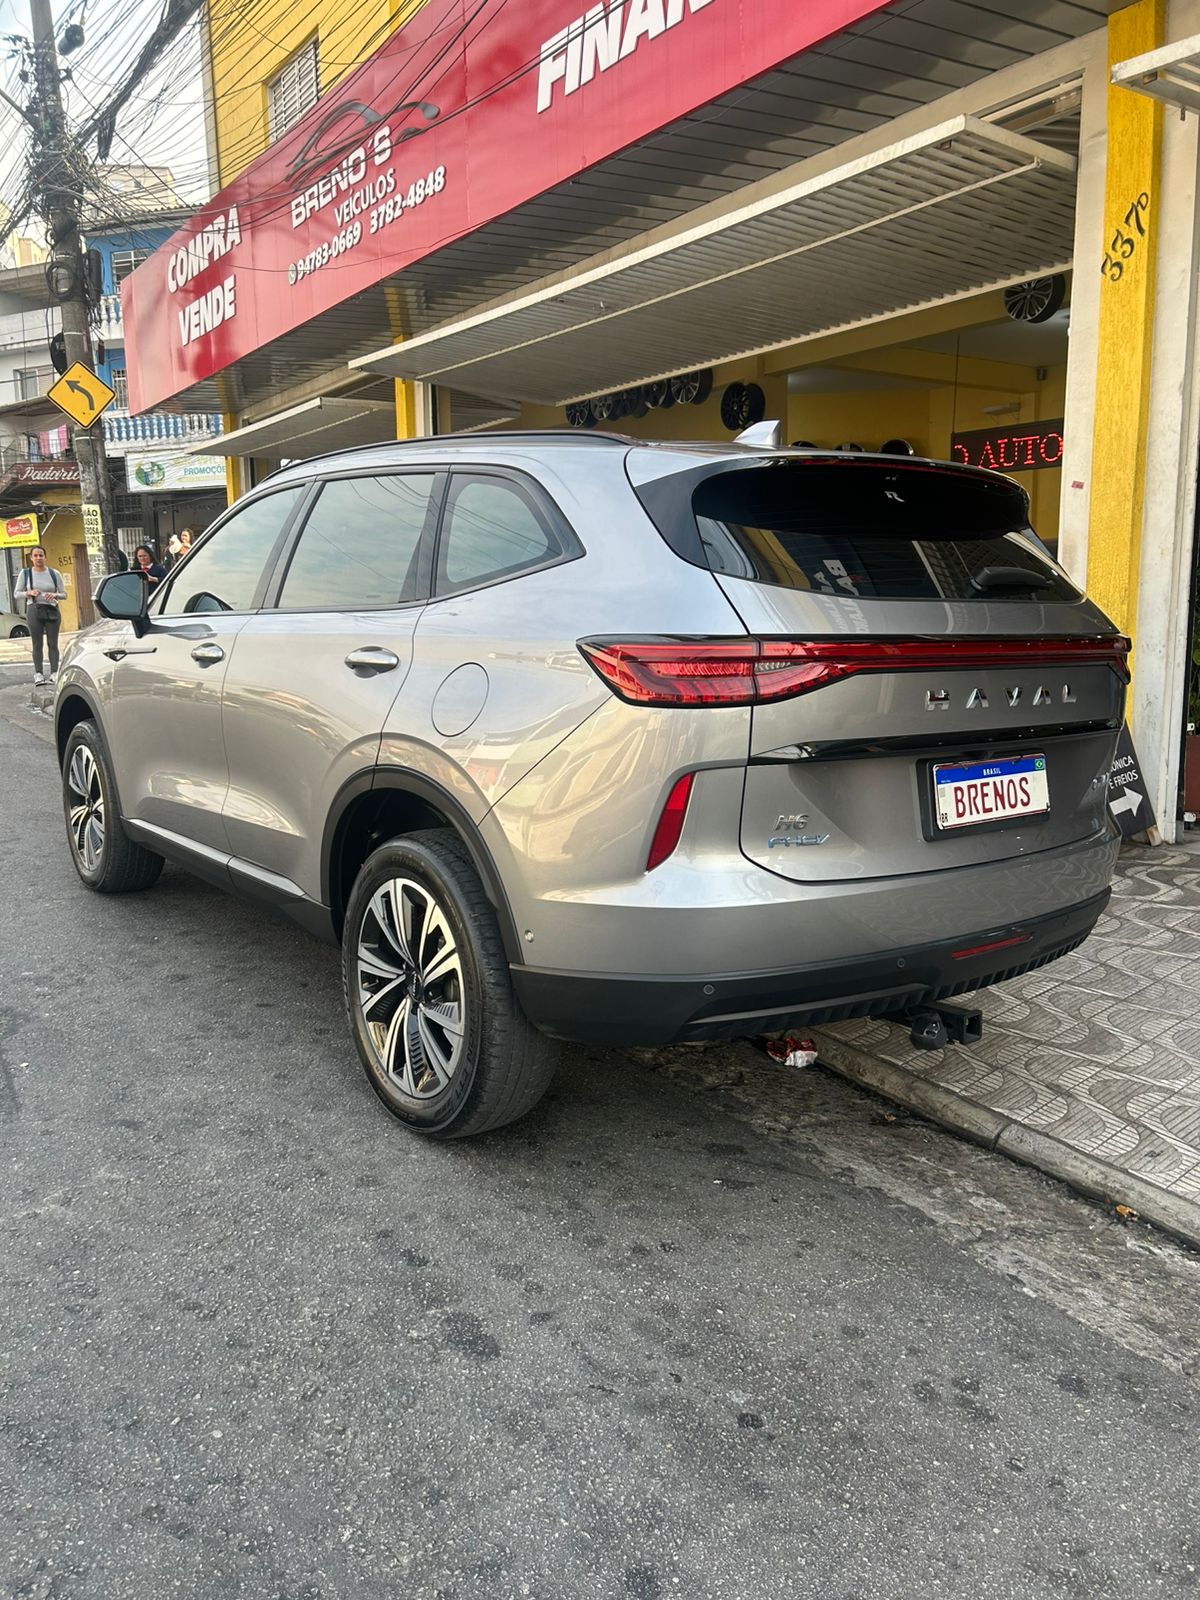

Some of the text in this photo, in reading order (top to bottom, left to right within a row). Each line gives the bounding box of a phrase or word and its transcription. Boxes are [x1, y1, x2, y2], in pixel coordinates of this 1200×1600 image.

[334, 167, 397, 227] VEÍCULOS
[296, 164, 447, 281] 94783-0669 3782-4848
[167, 203, 242, 294] COMPRA
[178, 273, 237, 347] VENDE
[976, 431, 1064, 470] AUTO
[58, 555, 73, 567] 851
[926, 684, 1077, 711] HAVAL
[983, 767, 1002, 776] BRASIL
[1113, 769, 1139, 788] FREIOS
[954, 776, 1031, 819] BRENOS
[774, 813, 809, 831] H6
[768, 834, 830, 849] PHEV
